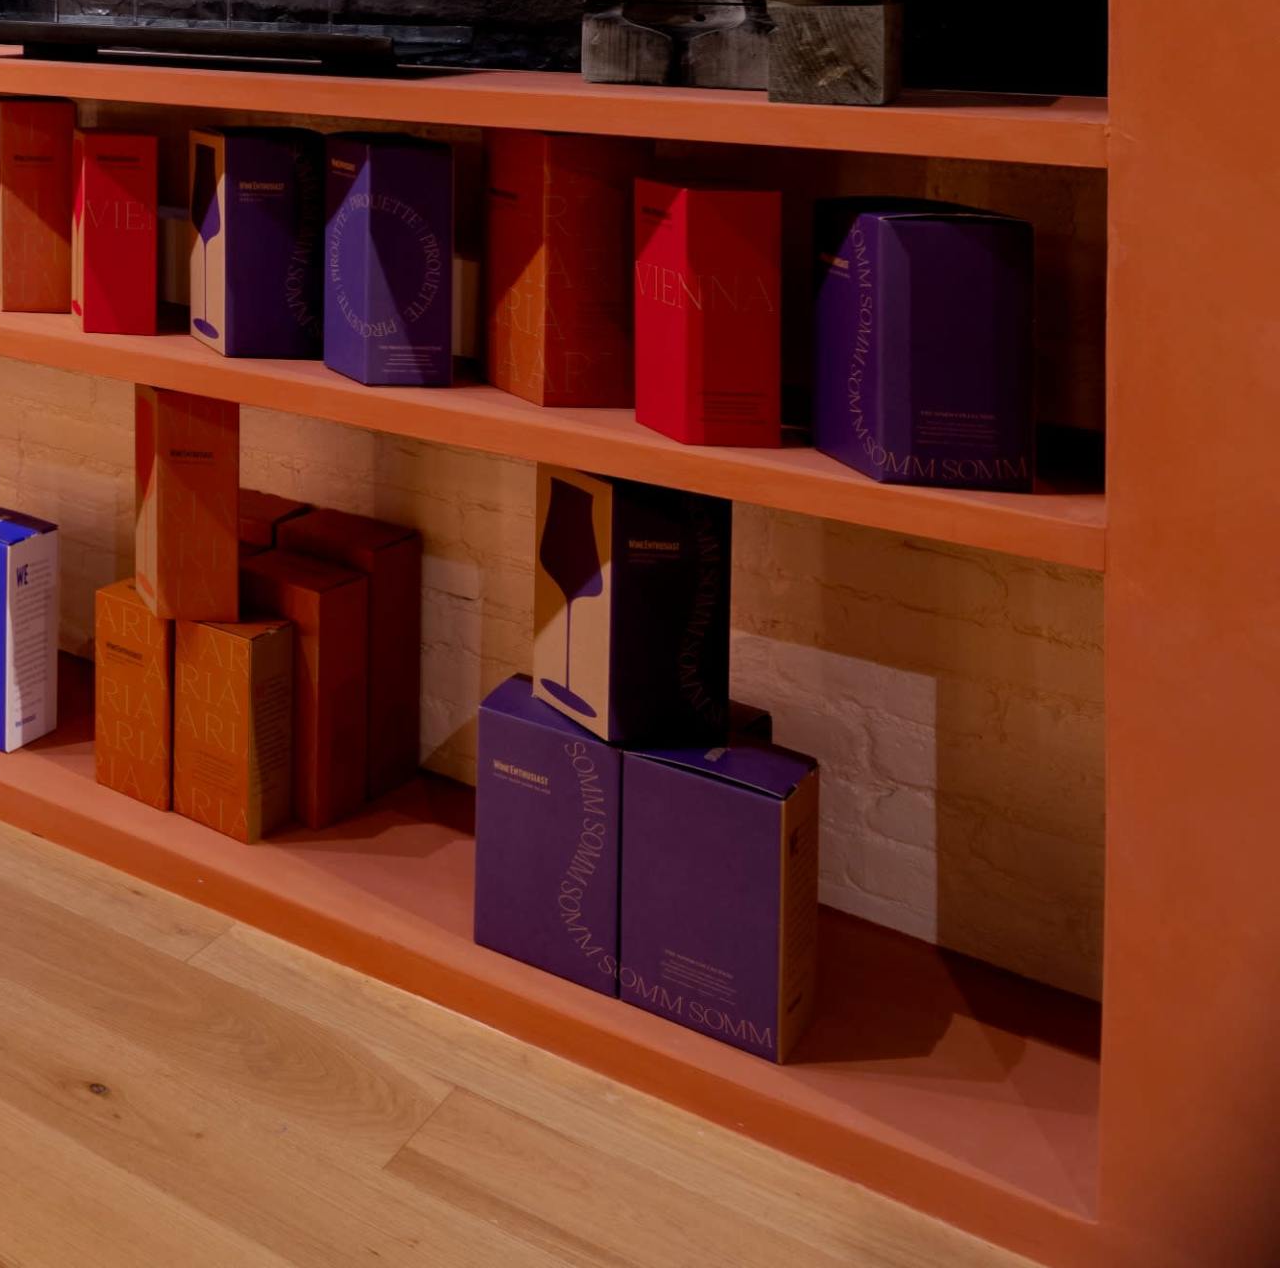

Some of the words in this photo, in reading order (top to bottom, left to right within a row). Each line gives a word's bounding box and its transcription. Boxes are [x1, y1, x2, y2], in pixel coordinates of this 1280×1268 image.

[635, 259, 776, 313] VIENNA
[565, 741, 606, 816] SOMM
[689, 1001, 773, 1048] SOMM
